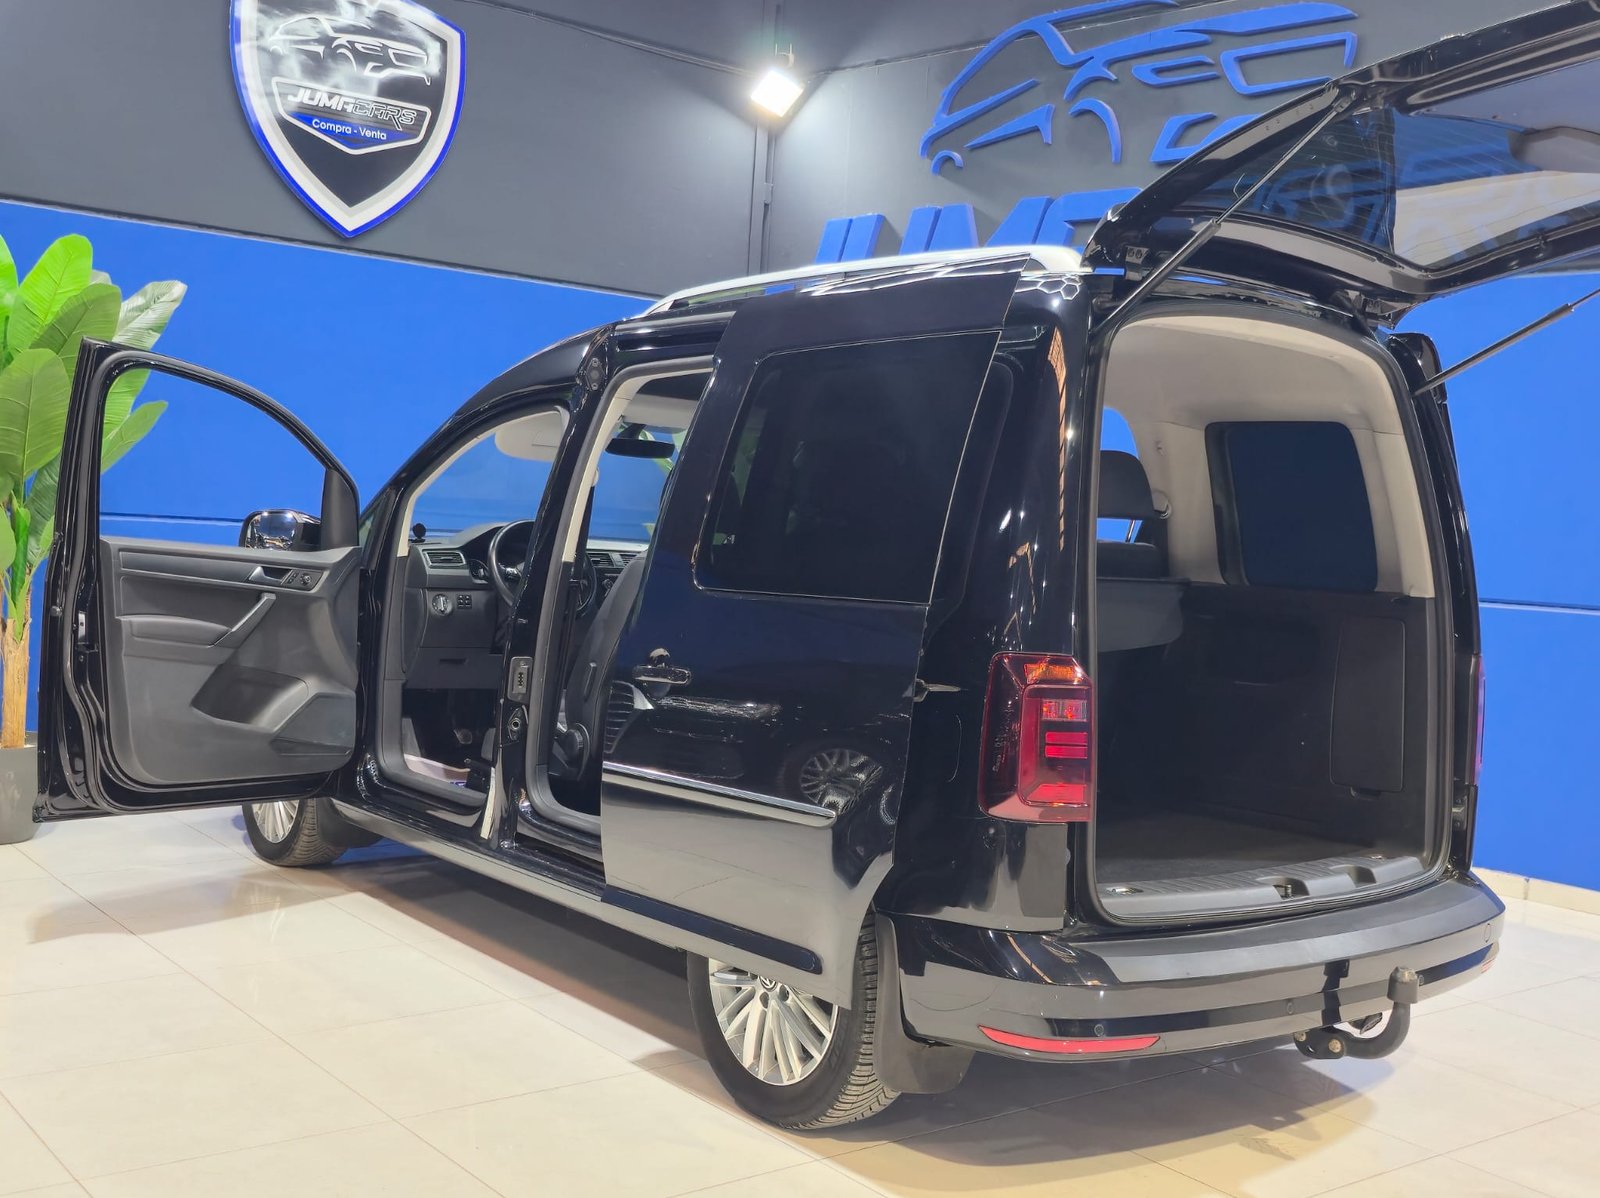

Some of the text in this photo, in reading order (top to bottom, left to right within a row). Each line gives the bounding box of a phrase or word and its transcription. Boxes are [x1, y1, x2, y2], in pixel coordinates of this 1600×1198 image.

[287, 88, 417, 131] JUMACARS
[312, 118, 352, 134] Compra
[359, 127, 387, 140] Venta
